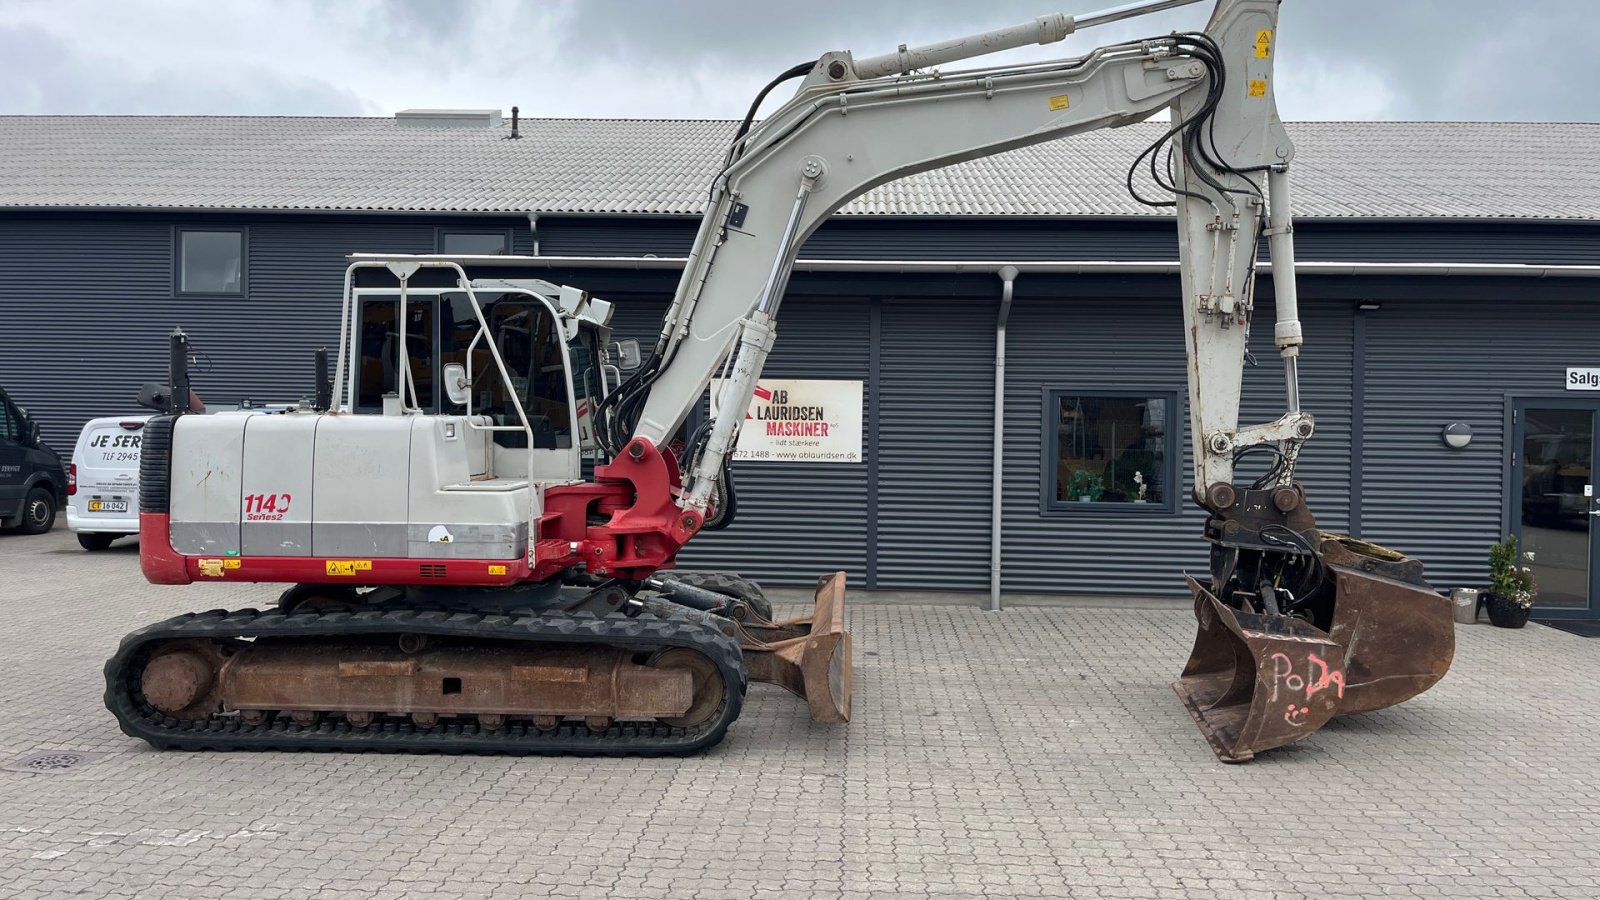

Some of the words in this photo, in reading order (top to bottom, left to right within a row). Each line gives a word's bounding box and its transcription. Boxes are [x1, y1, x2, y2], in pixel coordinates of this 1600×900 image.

[1570, 371, 1600, 387] Salg
[772, 390, 788, 404] AB
[757, 406, 824, 421] LAURIDSEN
[766, 422, 829, 437] MASKINER
[91, 435, 110, 448] JE
[103, 452, 115, 461] TLF
[117, 452, 138, 461] 2945
[751, 451, 770, 459] 1488
[776, 451, 857, 460] www.ablauridsen.dk
[92, 502, 102, 510] CT
[103, 502, 111, 510] 16
[112, 502, 124, 510] 042
[247, 513, 283, 521] Series2
